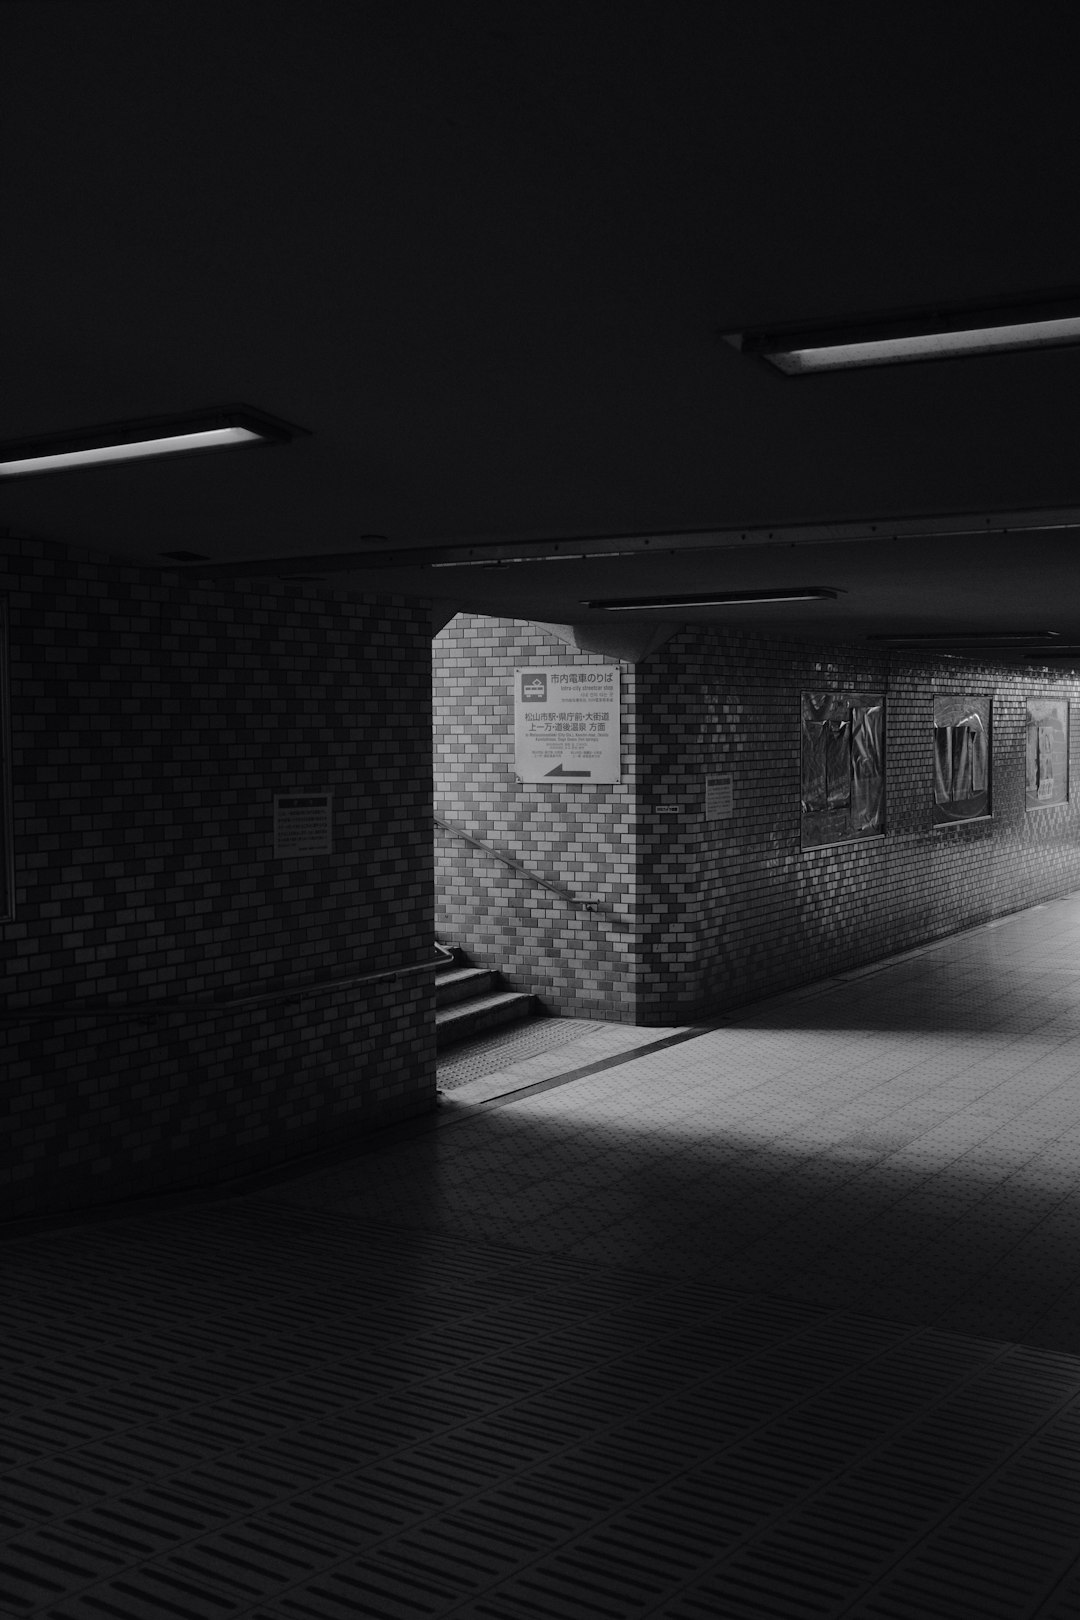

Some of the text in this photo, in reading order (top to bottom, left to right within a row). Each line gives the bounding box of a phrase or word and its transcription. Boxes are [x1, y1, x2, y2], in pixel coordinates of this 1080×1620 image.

[551, 673, 613, 683] 市内電車のりば
[589, 722, 605, 731] 方面
